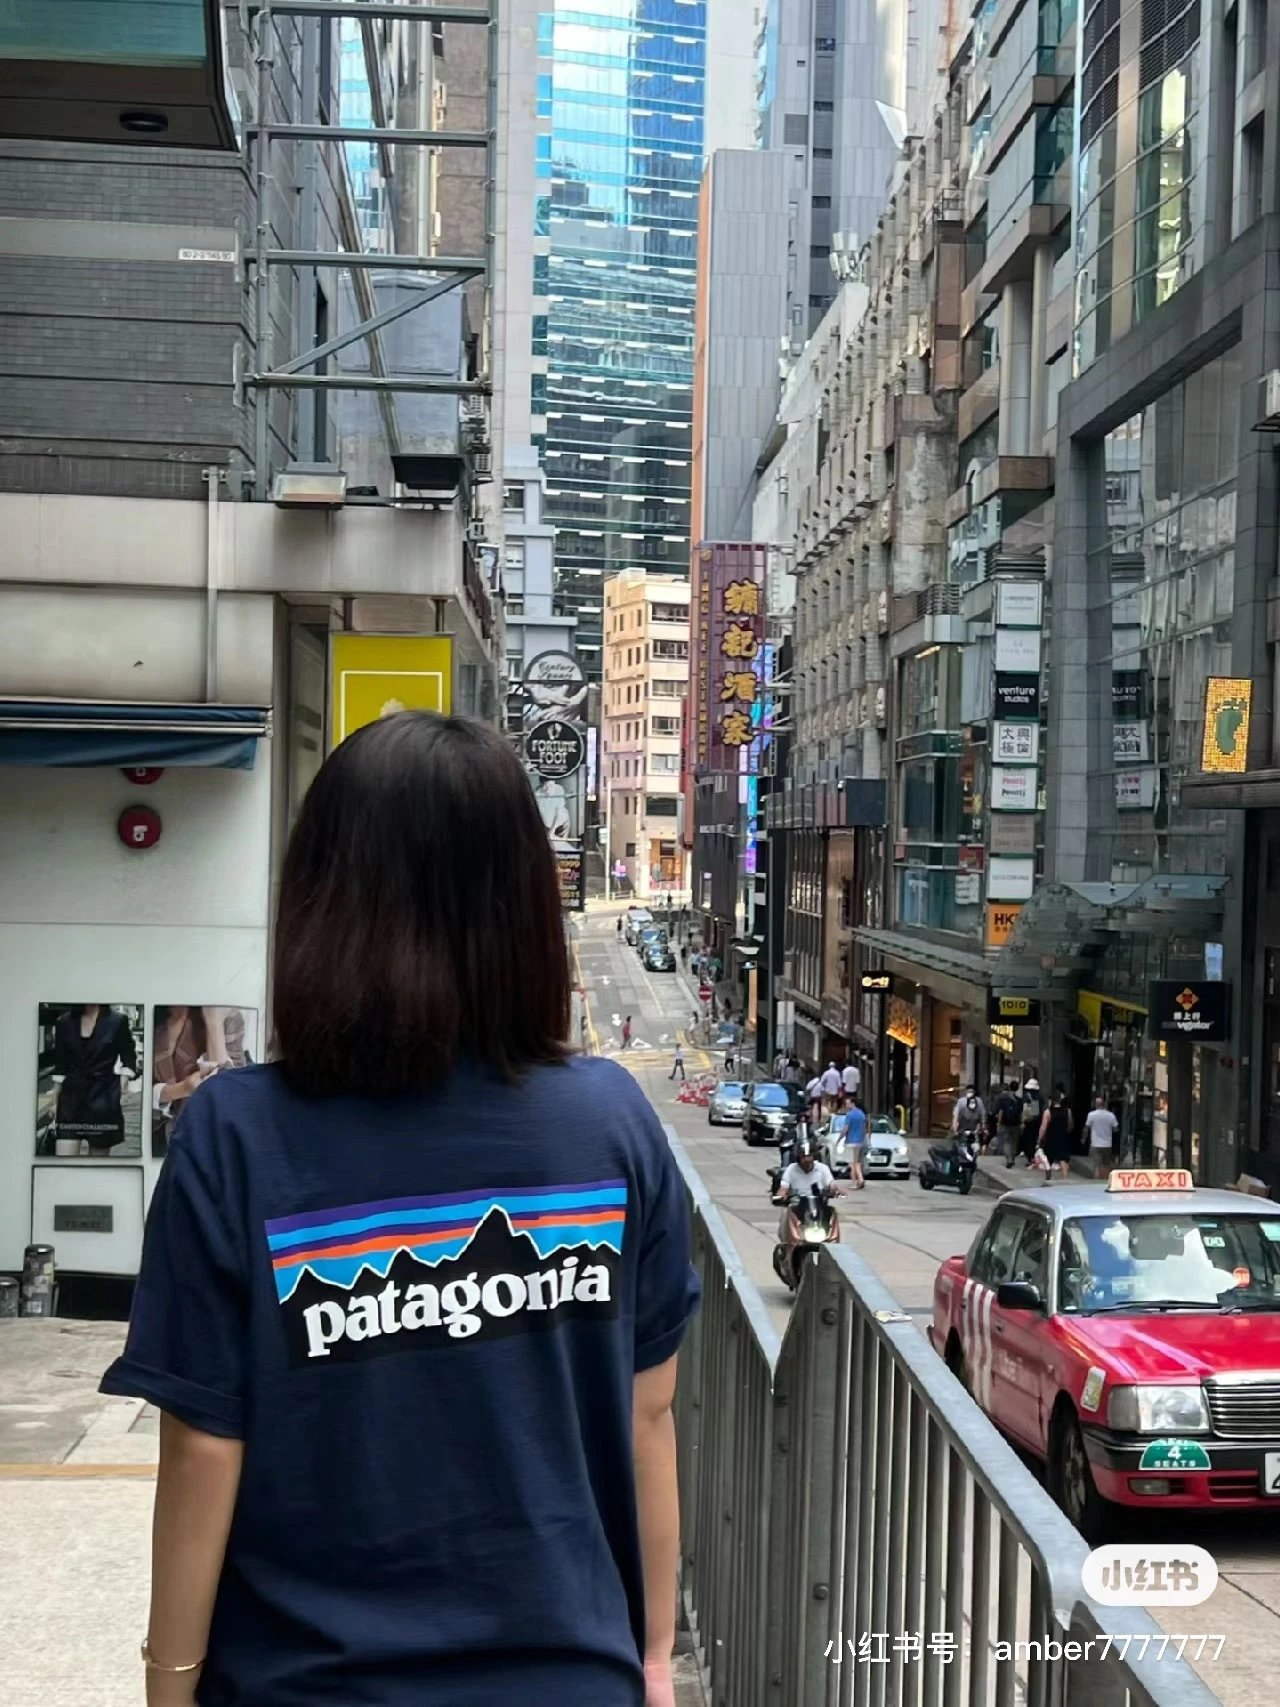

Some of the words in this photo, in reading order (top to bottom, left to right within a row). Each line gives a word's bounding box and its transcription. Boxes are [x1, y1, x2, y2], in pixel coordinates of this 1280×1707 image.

[998, 686, 1035, 697] venture
[531, 740, 577, 752] FORTUNE
[540, 752, 568, 764] FOOT
[994, 913, 1018, 925] HK
[1118, 1172, 1187, 1187] TAXI
[303, 1256, 611, 1357] patagonia
[1168, 1446, 1180, 1459] 4
[1154, 1460, 1196, 1468] SEATS
